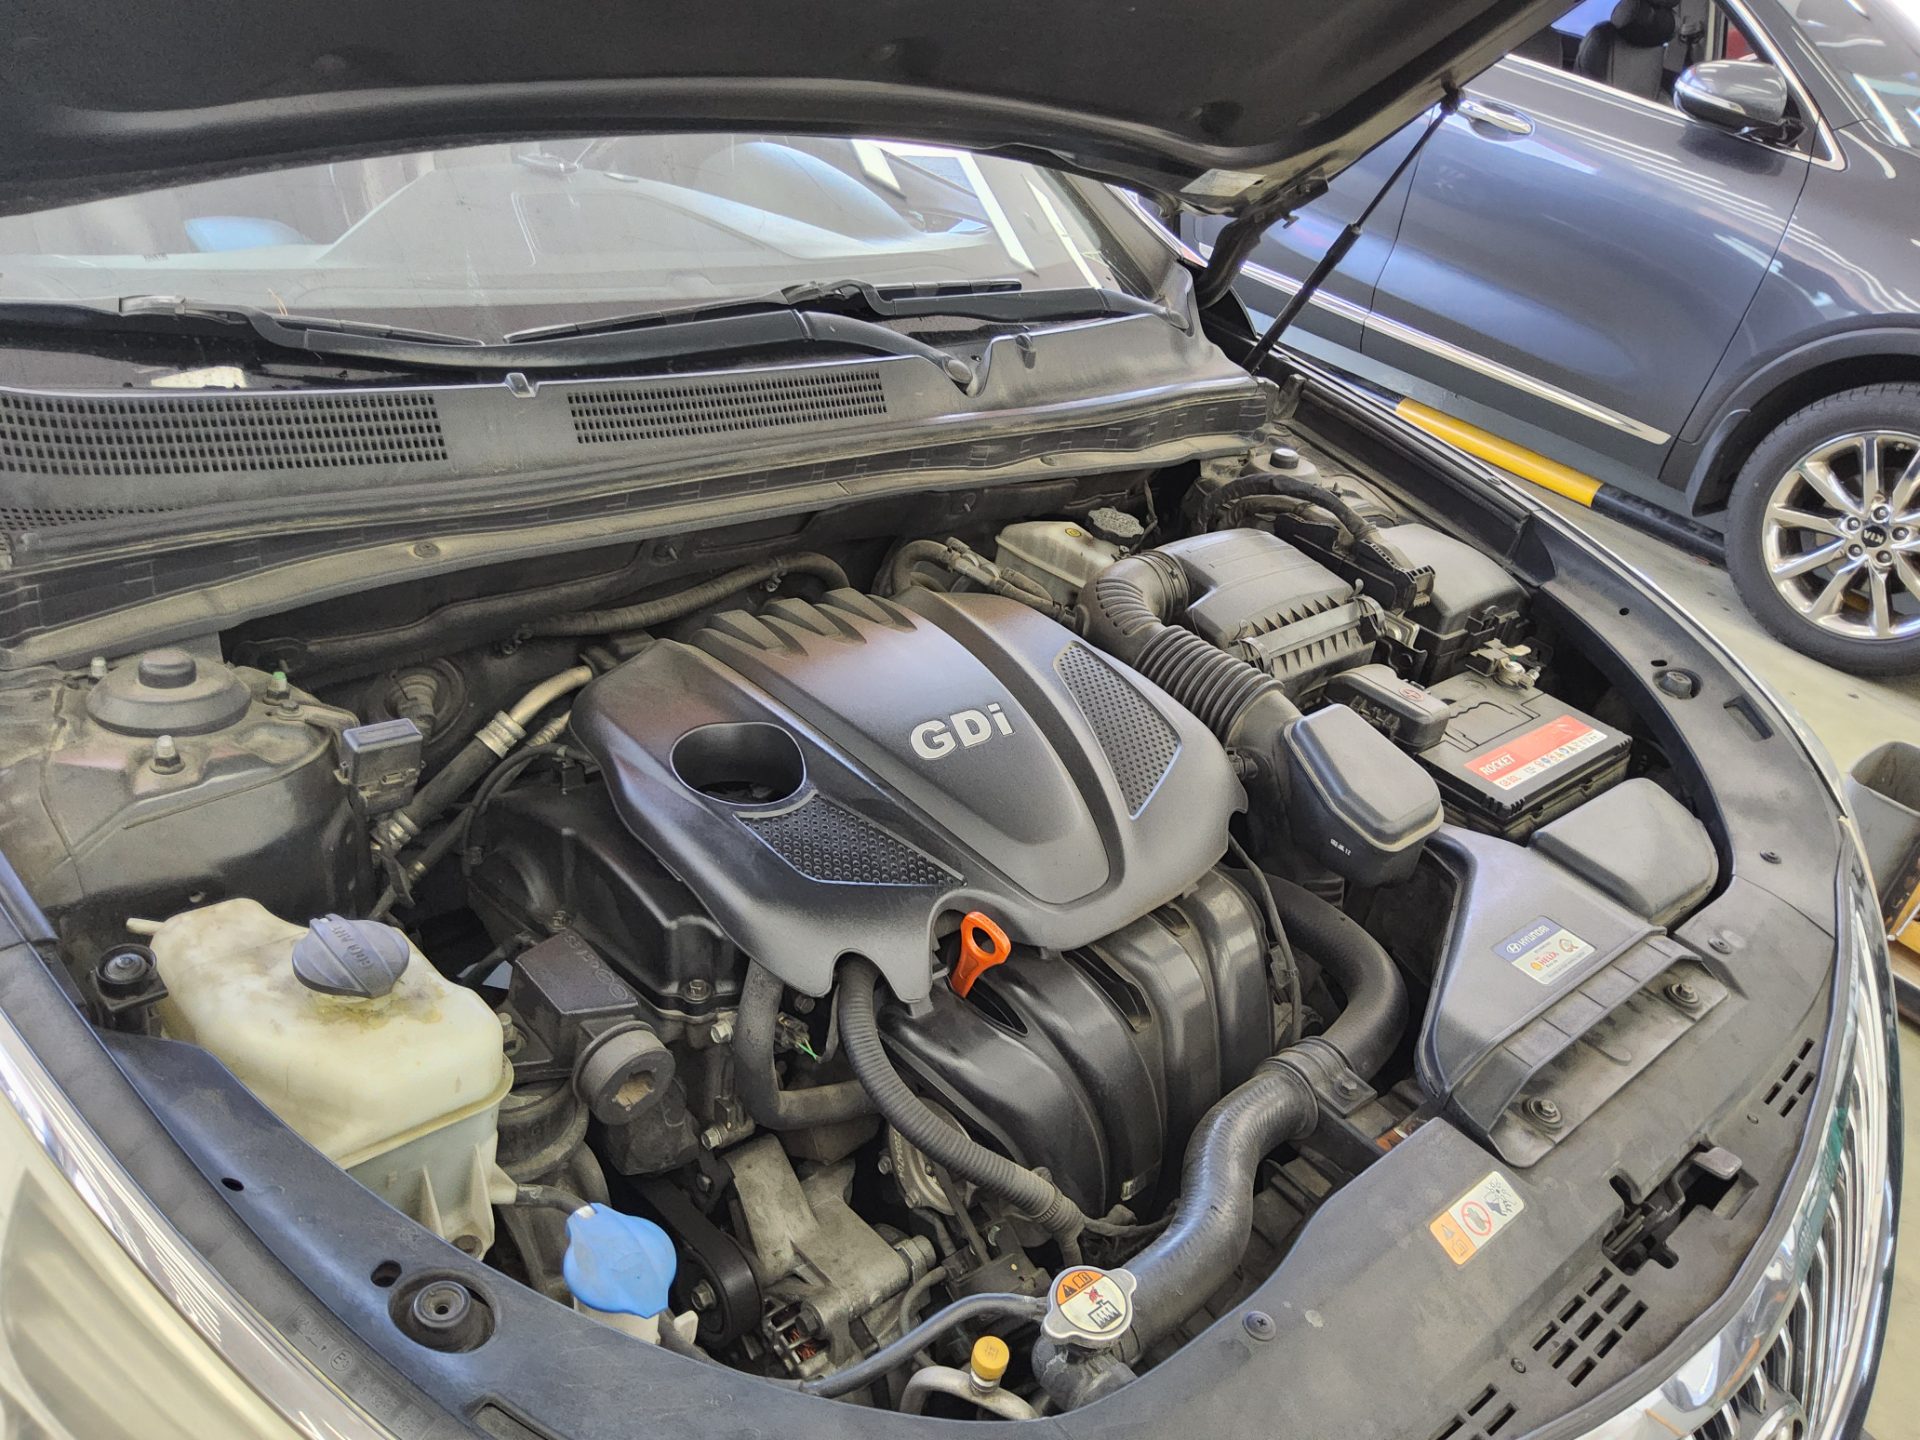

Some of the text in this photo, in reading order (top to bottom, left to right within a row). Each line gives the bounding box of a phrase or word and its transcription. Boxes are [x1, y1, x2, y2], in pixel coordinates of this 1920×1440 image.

[1863, 529, 1884, 544] KIA
[910, 702, 1014, 759] GDi
[1479, 753, 1516, 776] ROCKET
[1518, 925, 1550, 946] HYUNDAI
